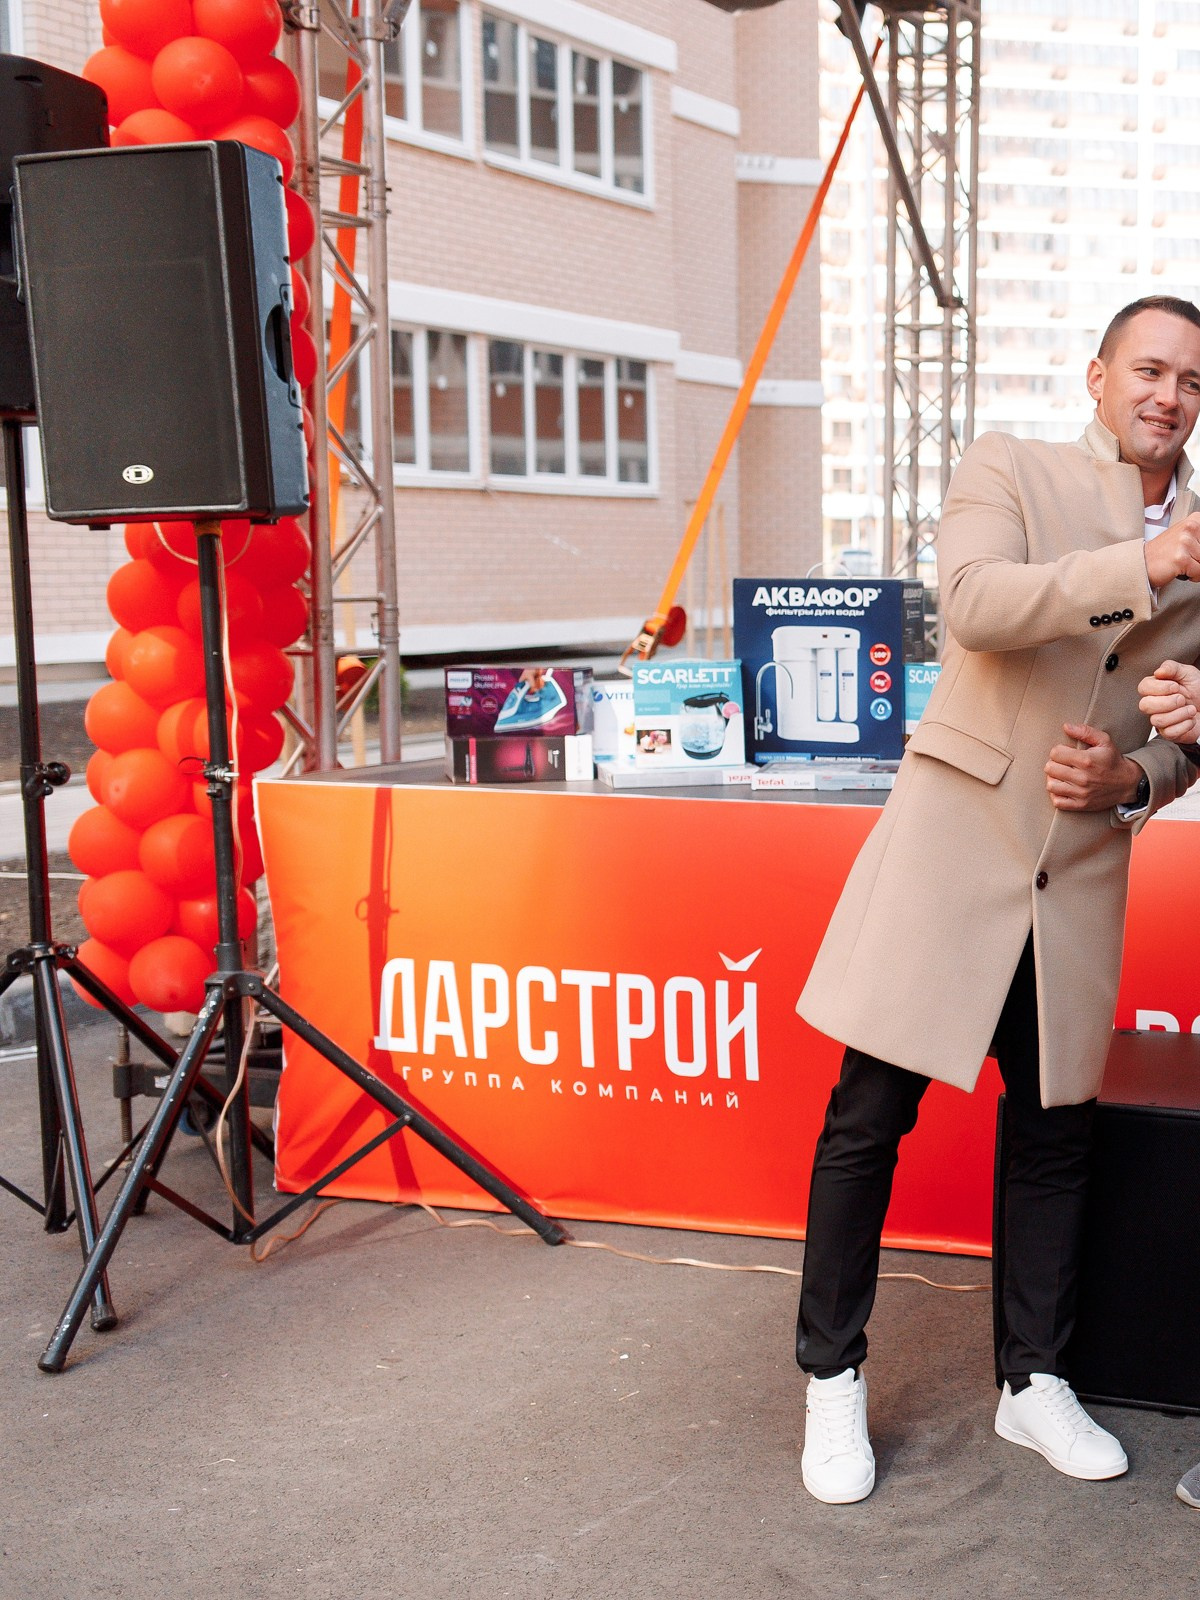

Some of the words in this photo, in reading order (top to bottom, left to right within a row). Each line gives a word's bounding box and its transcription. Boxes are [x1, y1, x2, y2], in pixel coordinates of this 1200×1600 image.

[752, 587, 879, 608] АКВАФОР
[766, 607, 814, 617] фильтры
[814, 608, 836, 617] для
[836, 609, 865, 617] воды
[637, 667, 733, 685] SCARLETT
[908, 669, 942, 684] SCAR
[757, 778, 785, 786] Tefal
[374, 948, 763, 1081] ДАРСТРОЙ
[402, 1065, 525, 1091] ГРУППА
[550, 1079, 740, 1109] КОМПАНИЙ
